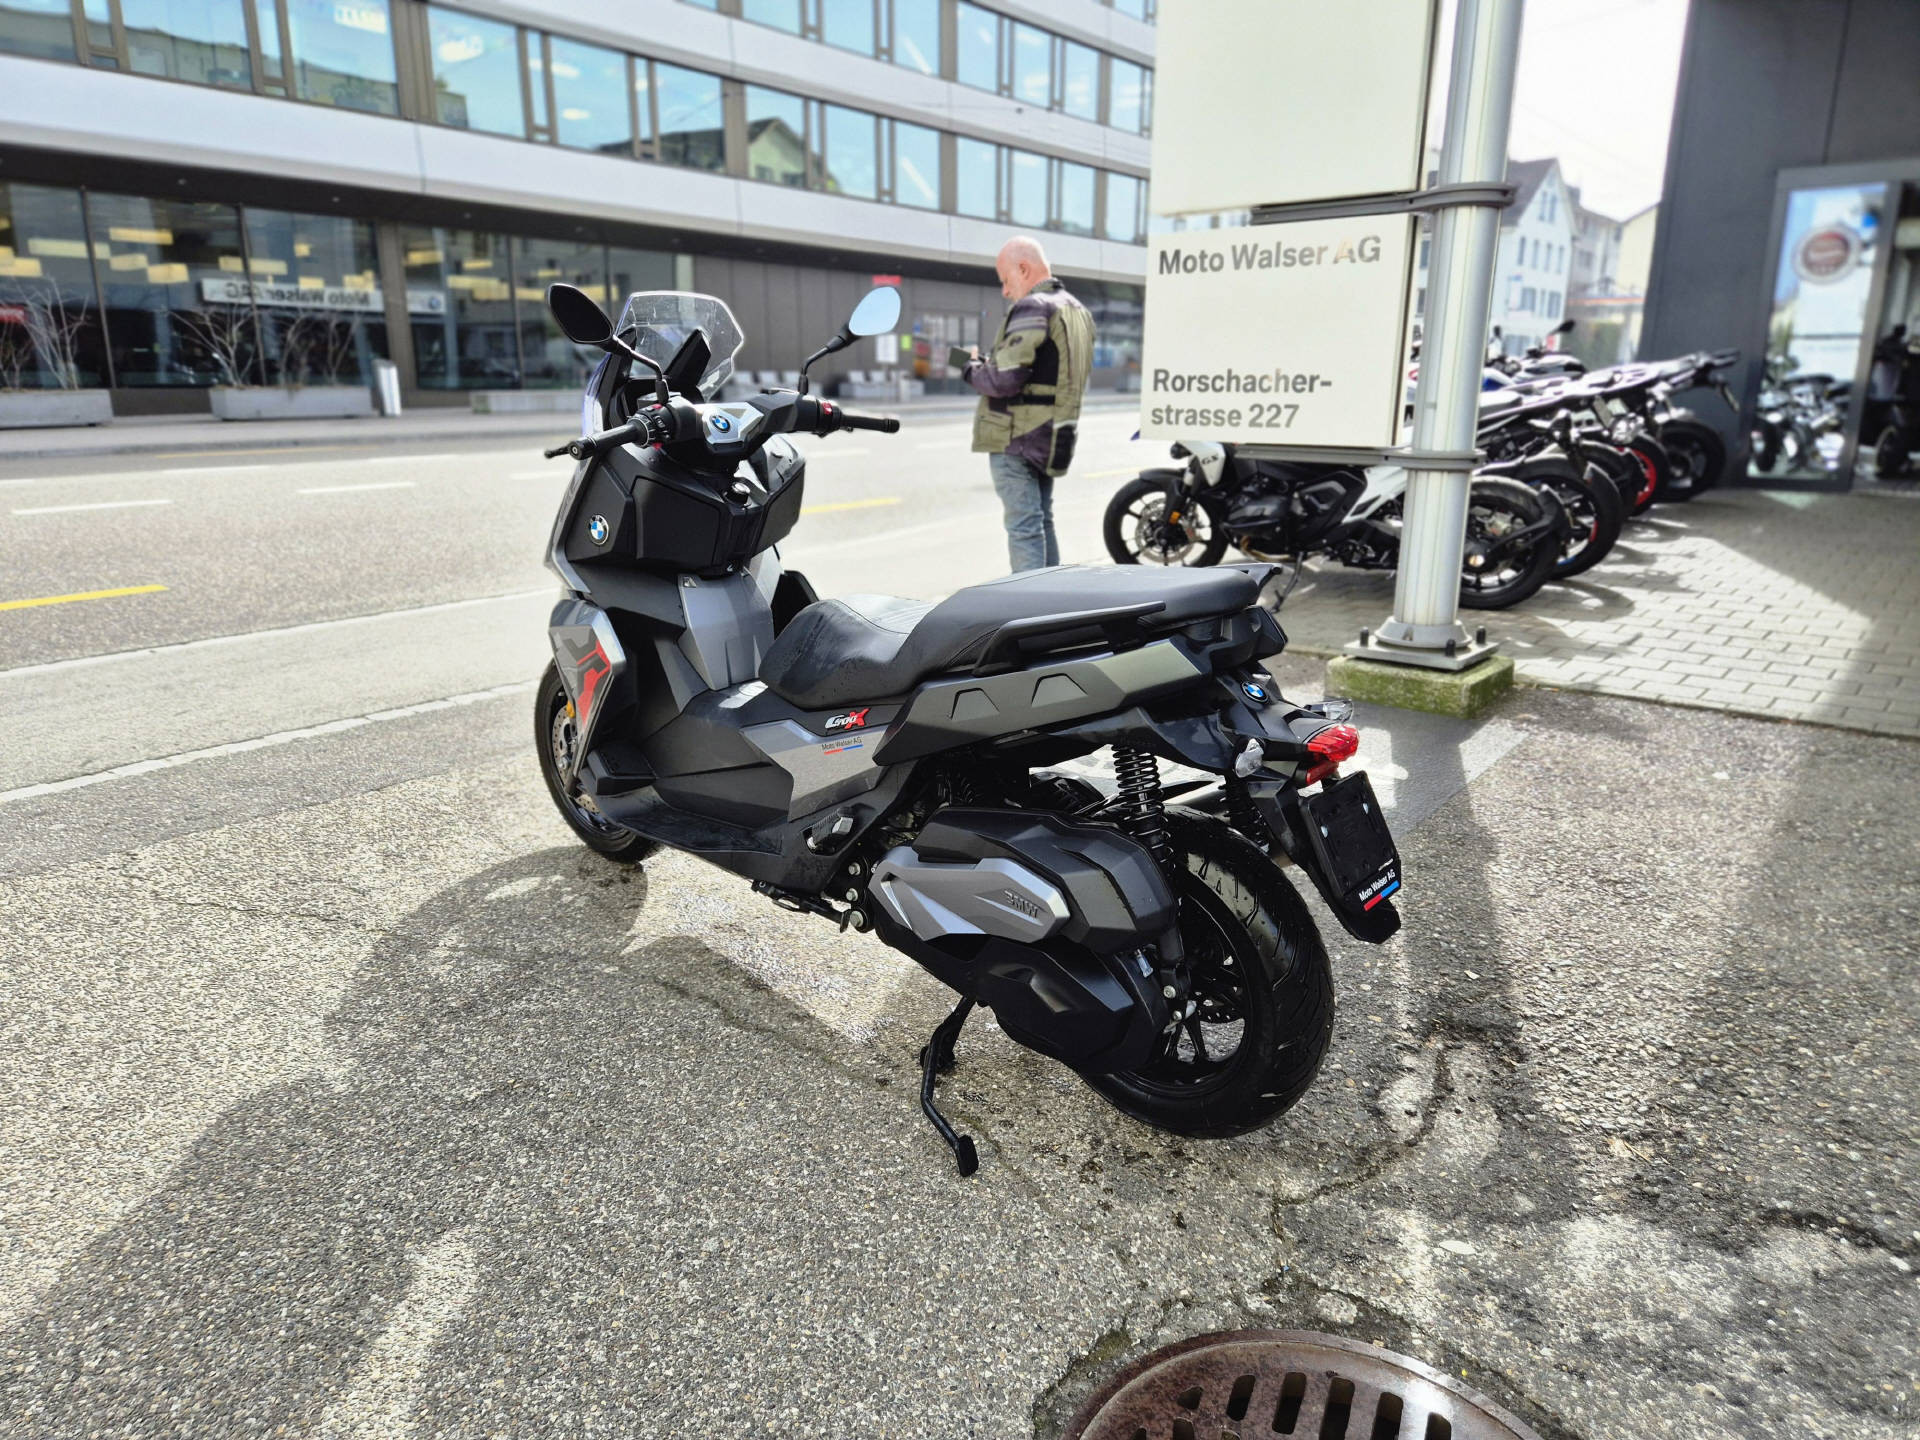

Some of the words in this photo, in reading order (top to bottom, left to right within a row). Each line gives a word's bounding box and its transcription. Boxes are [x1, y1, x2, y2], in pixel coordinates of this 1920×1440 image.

[1158, 249, 1225, 275] Moto
[1231, 241, 1328, 270] Walser
[1333, 235, 1382, 265] AG
[1152, 368, 1333, 394] Rorschacher-
[1150, 404, 1242, 427] strasse
[1247, 404, 1300, 428] 227
[1359, 887, 1373, 901] Moto
[1371, 875, 1388, 892] Walser
[1387, 868, 1396, 880] AG
[1004, 890, 1038, 918] BMW
